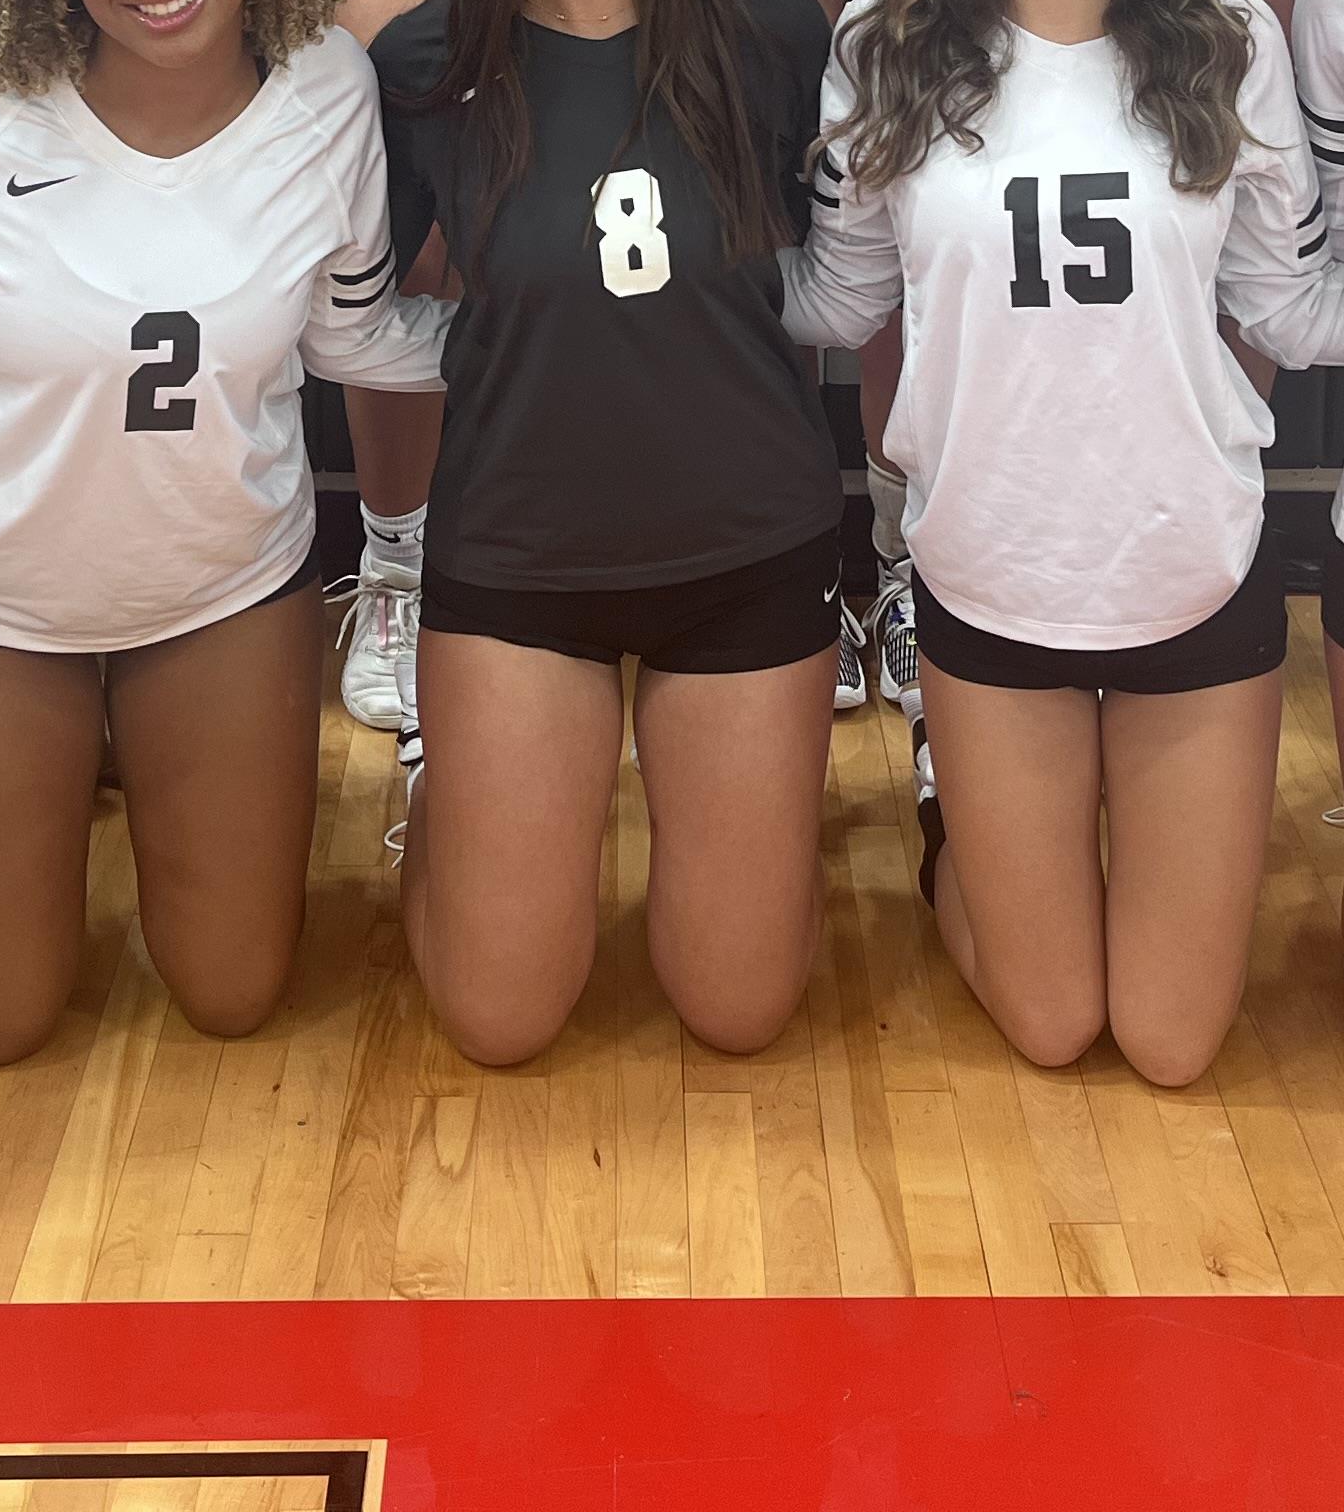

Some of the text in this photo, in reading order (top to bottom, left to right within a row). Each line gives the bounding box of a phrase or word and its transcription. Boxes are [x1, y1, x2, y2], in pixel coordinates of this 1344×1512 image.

[590, 168, 671, 298] 8
[1003, 171, 1134, 308] 15
[124, 310, 201, 432] 2
